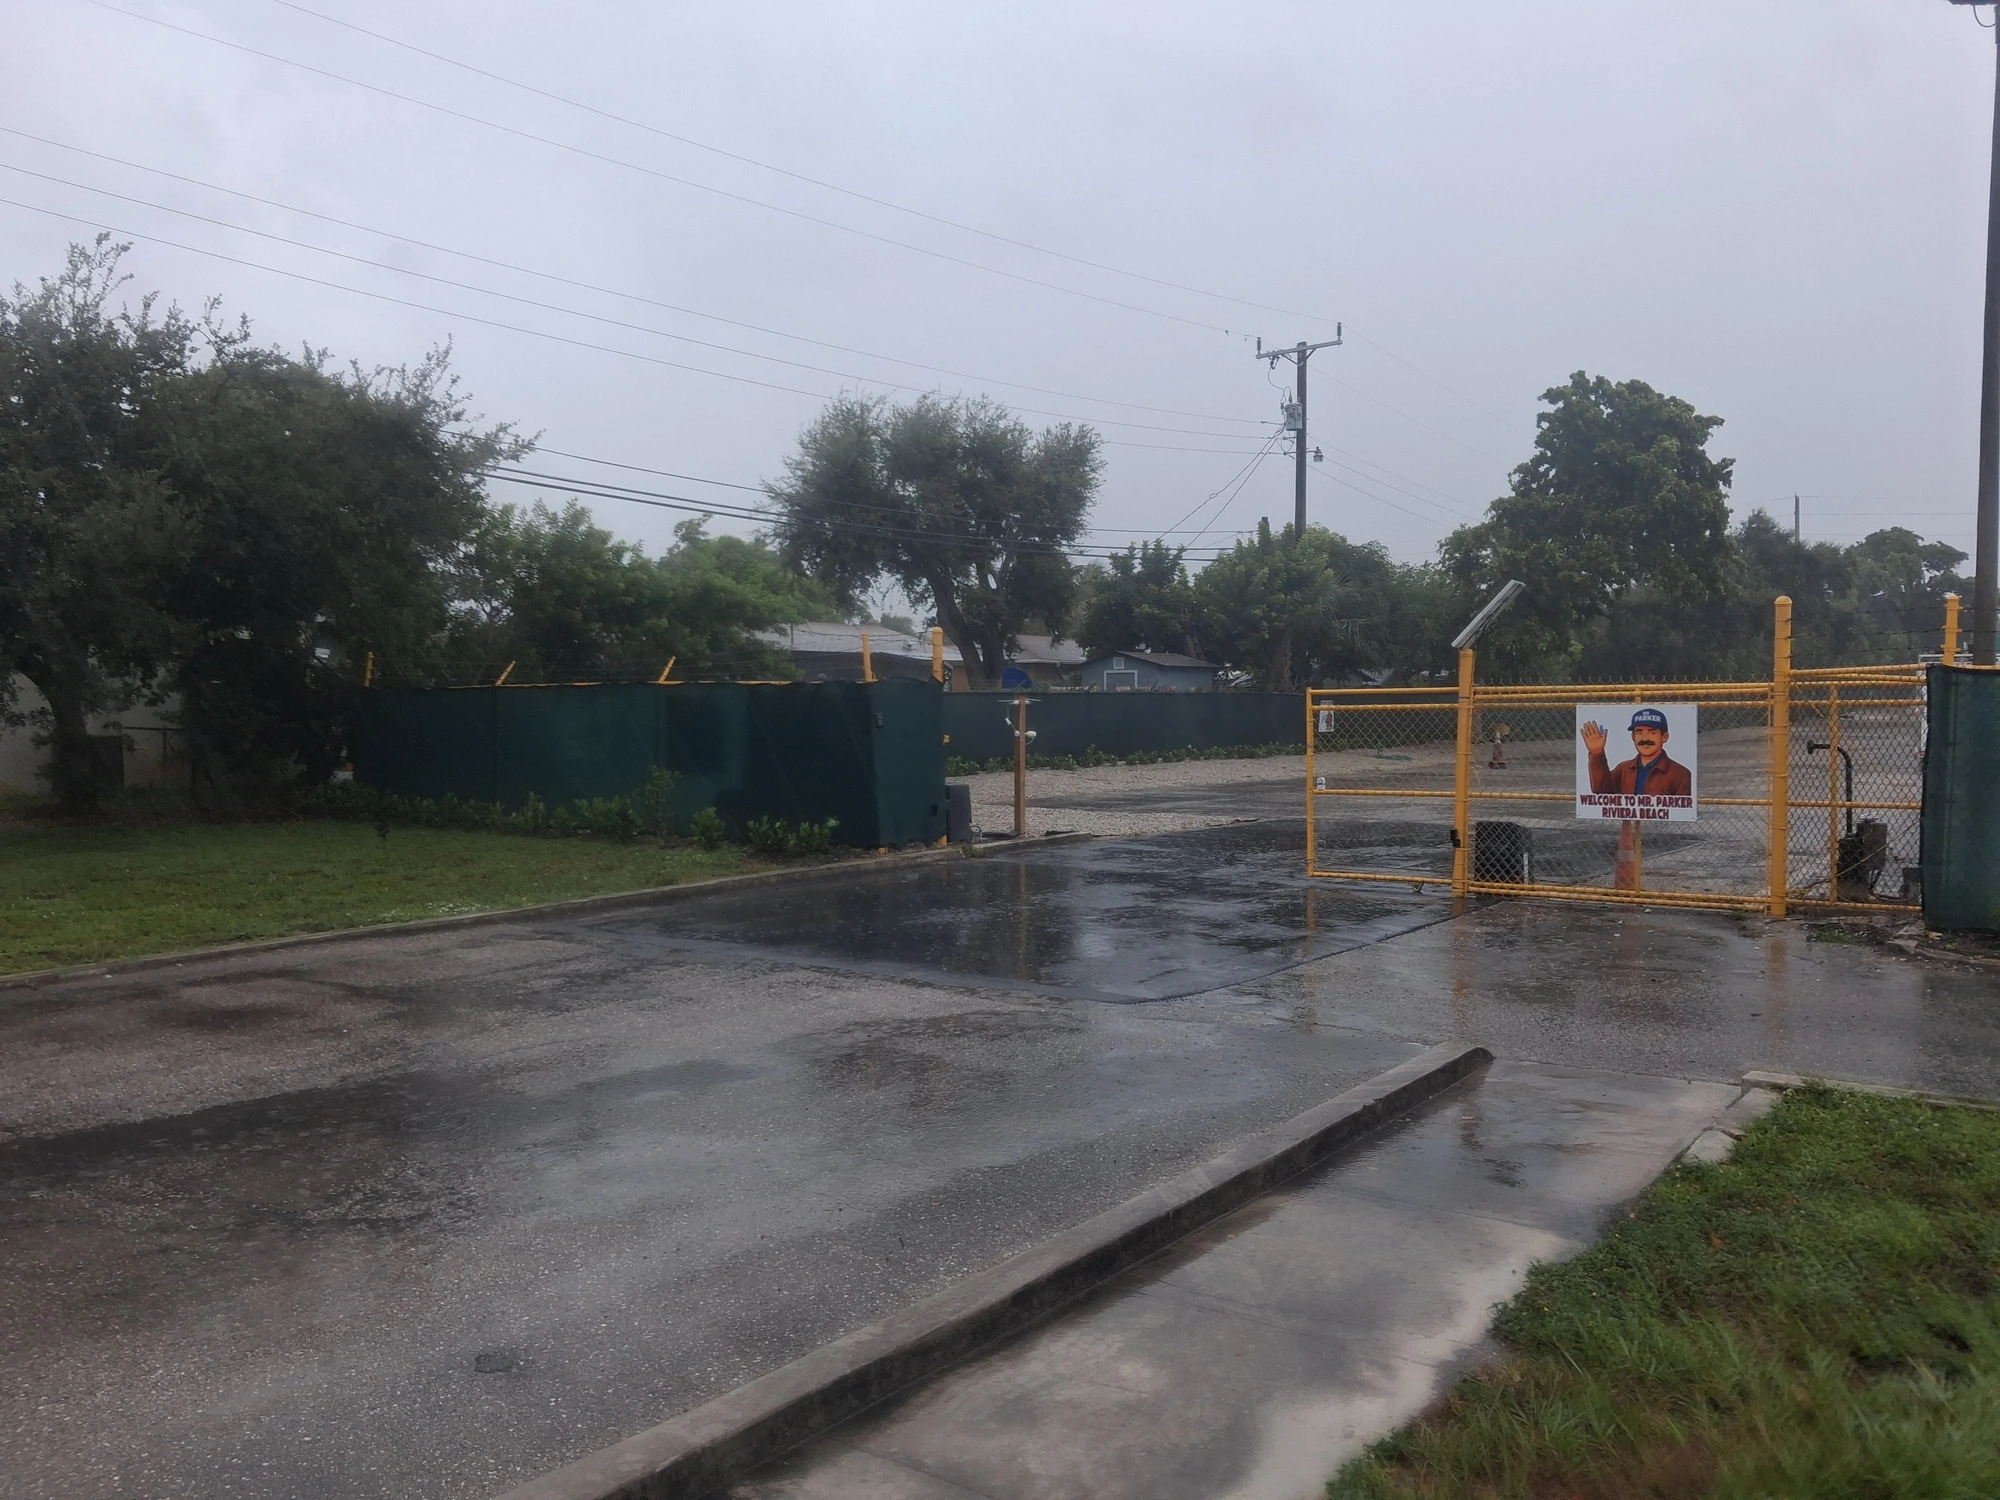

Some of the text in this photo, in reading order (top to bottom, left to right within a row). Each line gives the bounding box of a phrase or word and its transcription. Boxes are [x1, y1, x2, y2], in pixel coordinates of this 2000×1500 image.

[1580, 794, 1693, 809] WELCOME TO MR. PARKER
[1602, 807, 1670, 820] RIVIERA BEACH
